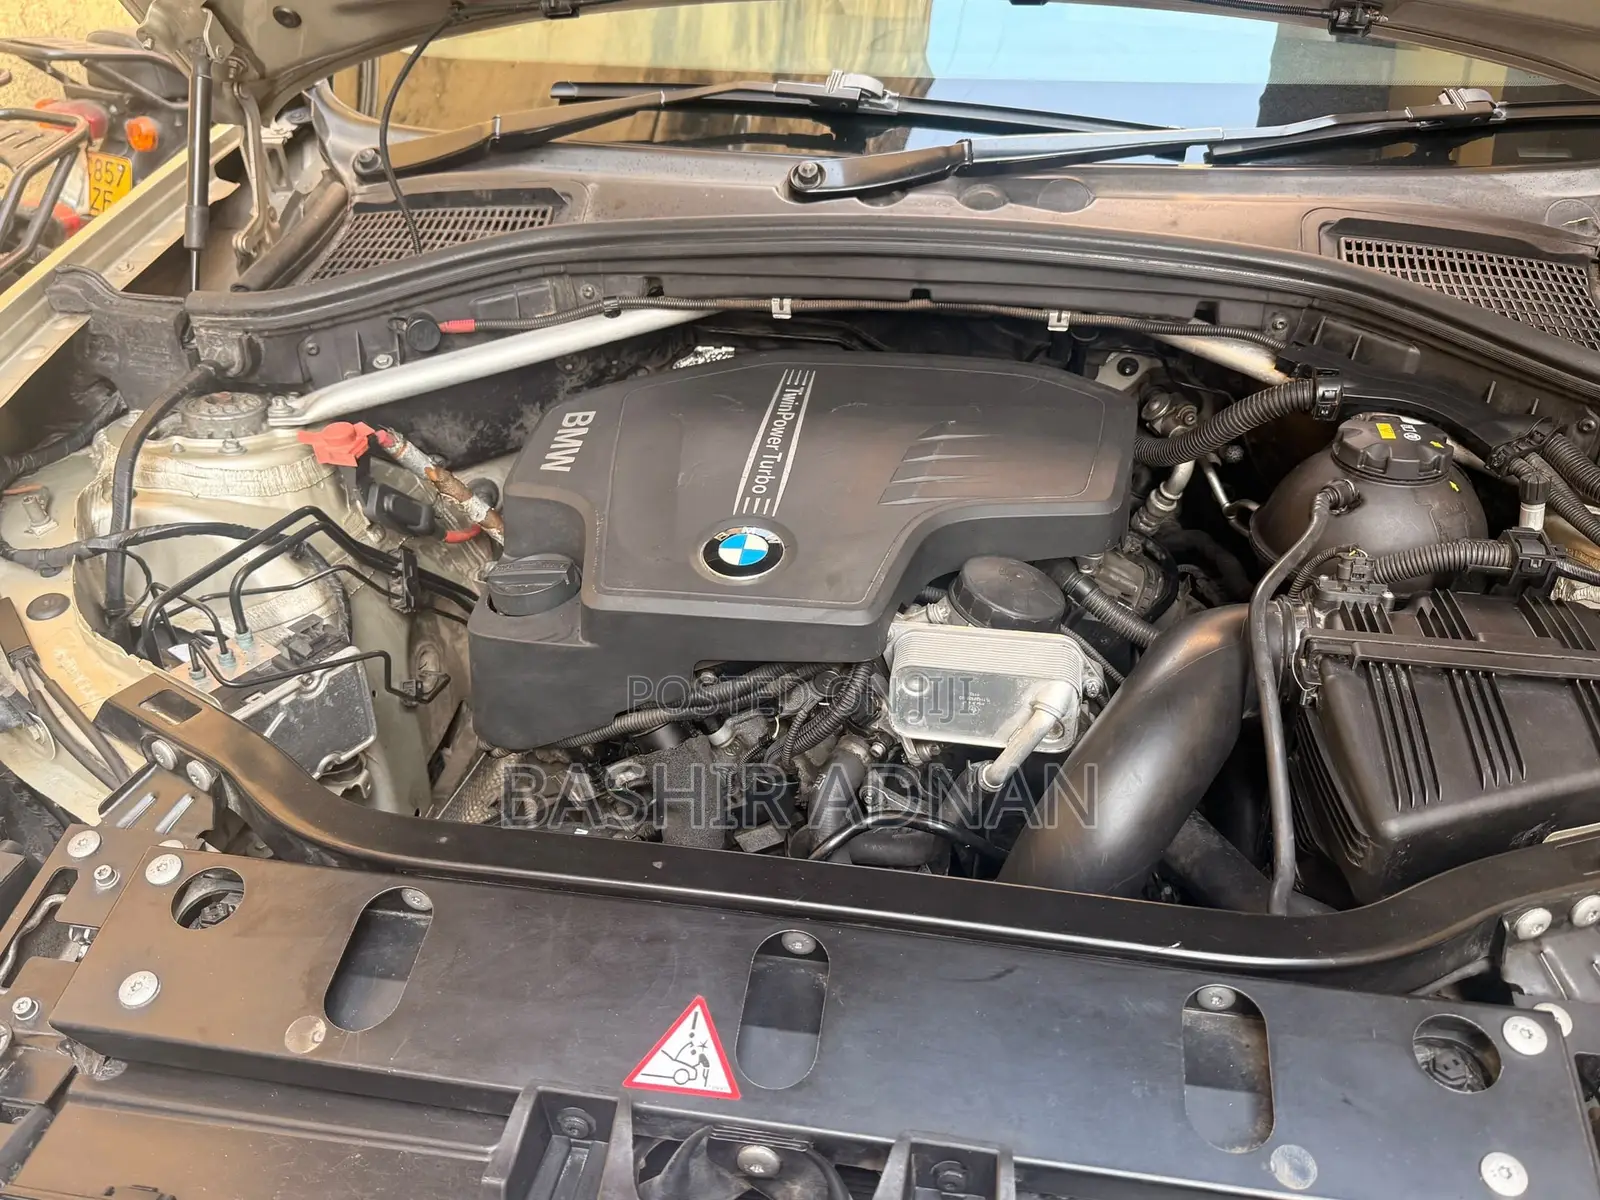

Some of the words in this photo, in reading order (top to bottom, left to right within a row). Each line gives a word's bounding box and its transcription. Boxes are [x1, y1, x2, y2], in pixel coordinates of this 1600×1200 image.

[540, 410, 597, 472] BMW
[766, 387, 805, 451] TwinPower
[752, 452, 783, 494] Turbo
